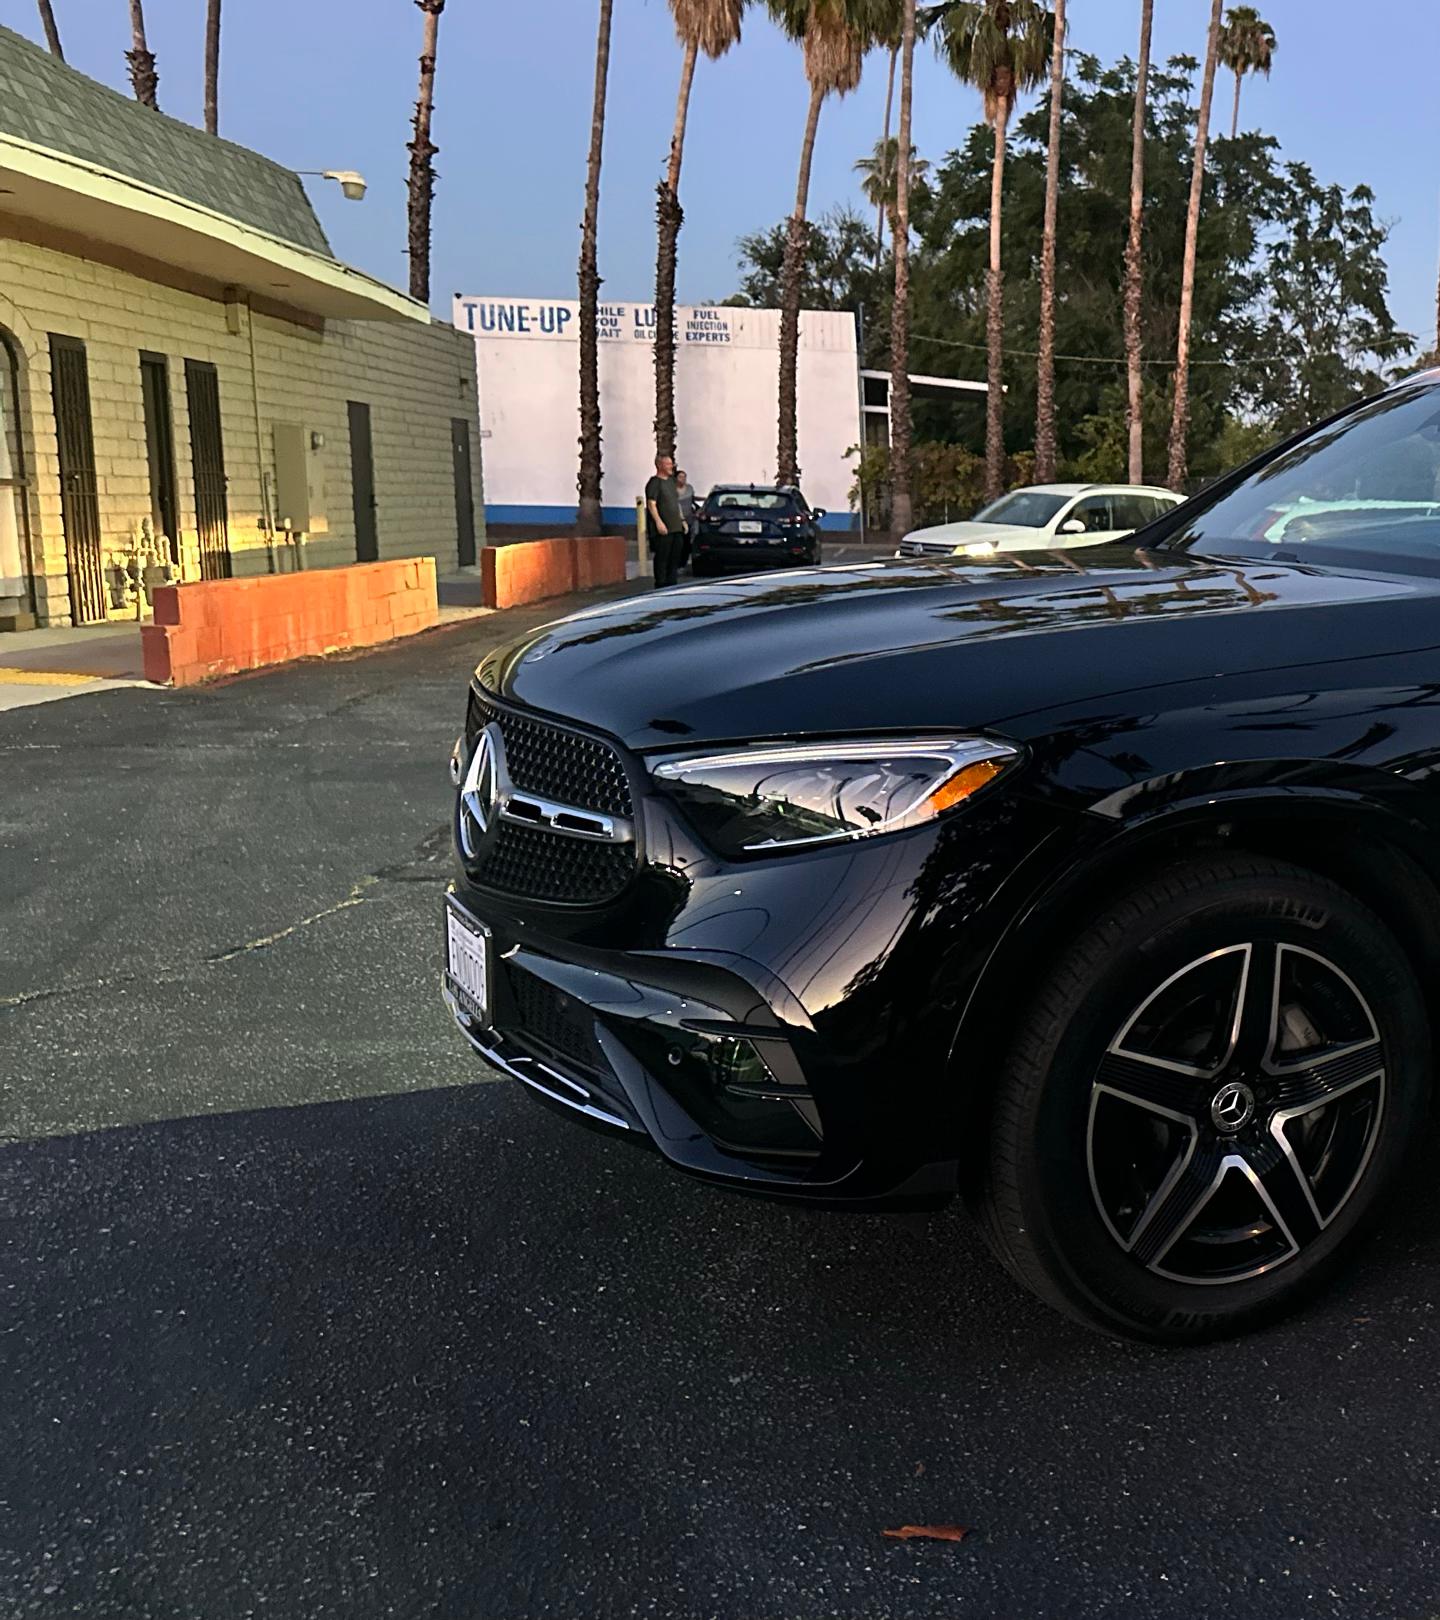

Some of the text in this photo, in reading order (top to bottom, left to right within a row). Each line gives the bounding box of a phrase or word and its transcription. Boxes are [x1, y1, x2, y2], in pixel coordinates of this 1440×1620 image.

[598, 307, 625, 316] HILE
[693, 310, 720, 320] FUEL
[463, 303, 572, 334] TUNE-UP
[597, 317, 618, 327] OU
[634, 308, 677, 327] LUE
[687, 321, 728, 331] INJECTION
[597, 329, 622, 338] AIT
[634, 329, 645, 339] OIL
[686, 332, 730, 342] EXPERTS
